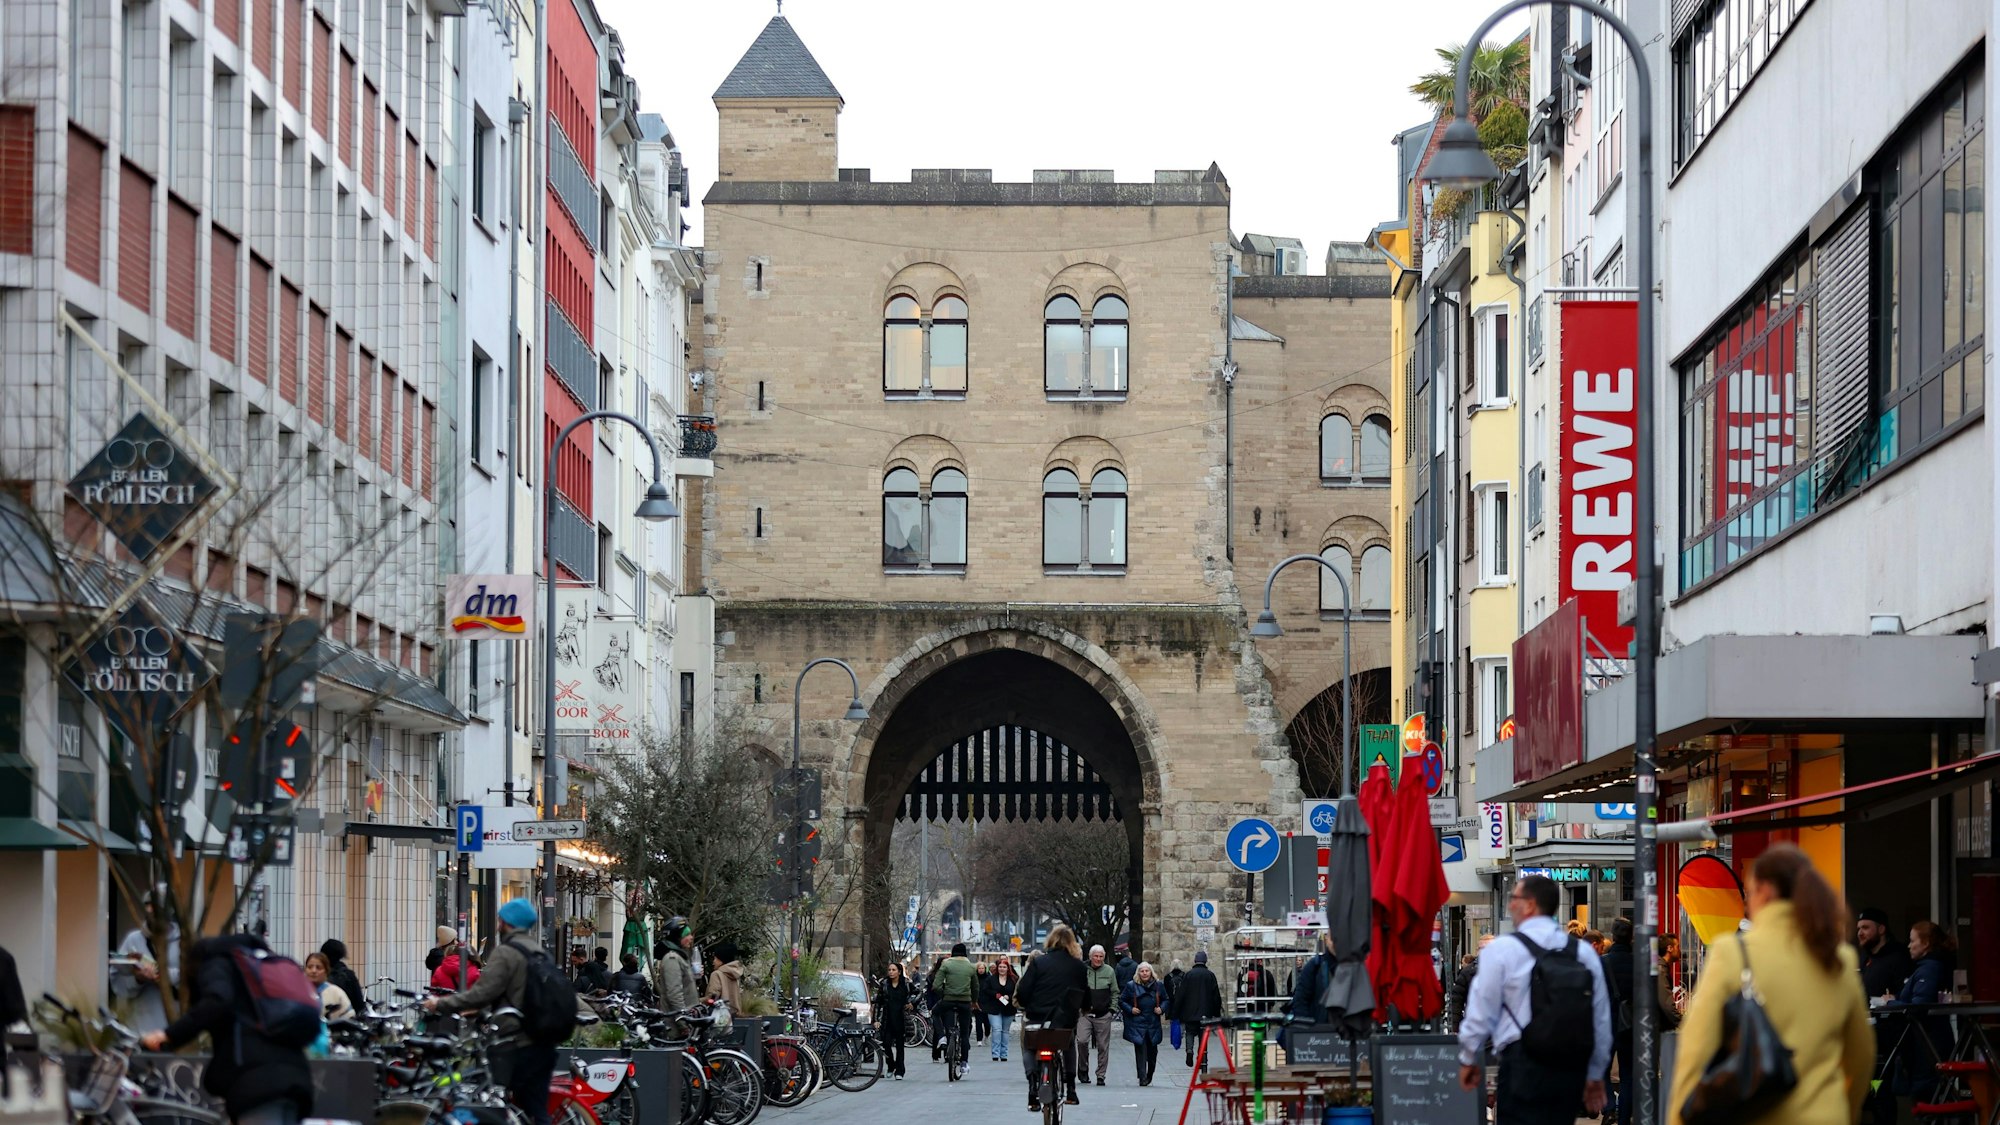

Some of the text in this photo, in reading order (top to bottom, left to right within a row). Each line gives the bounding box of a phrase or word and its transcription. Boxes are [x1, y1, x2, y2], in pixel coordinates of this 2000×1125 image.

[1571, 368, 1634, 591] REWE
[465, 584, 518, 615] dm
[557, 706, 588, 718] OOR
[593, 728, 629, 738] BOOR
[1367, 728, 1395, 743] THAI
[1405, 729, 1426, 740] KIO
